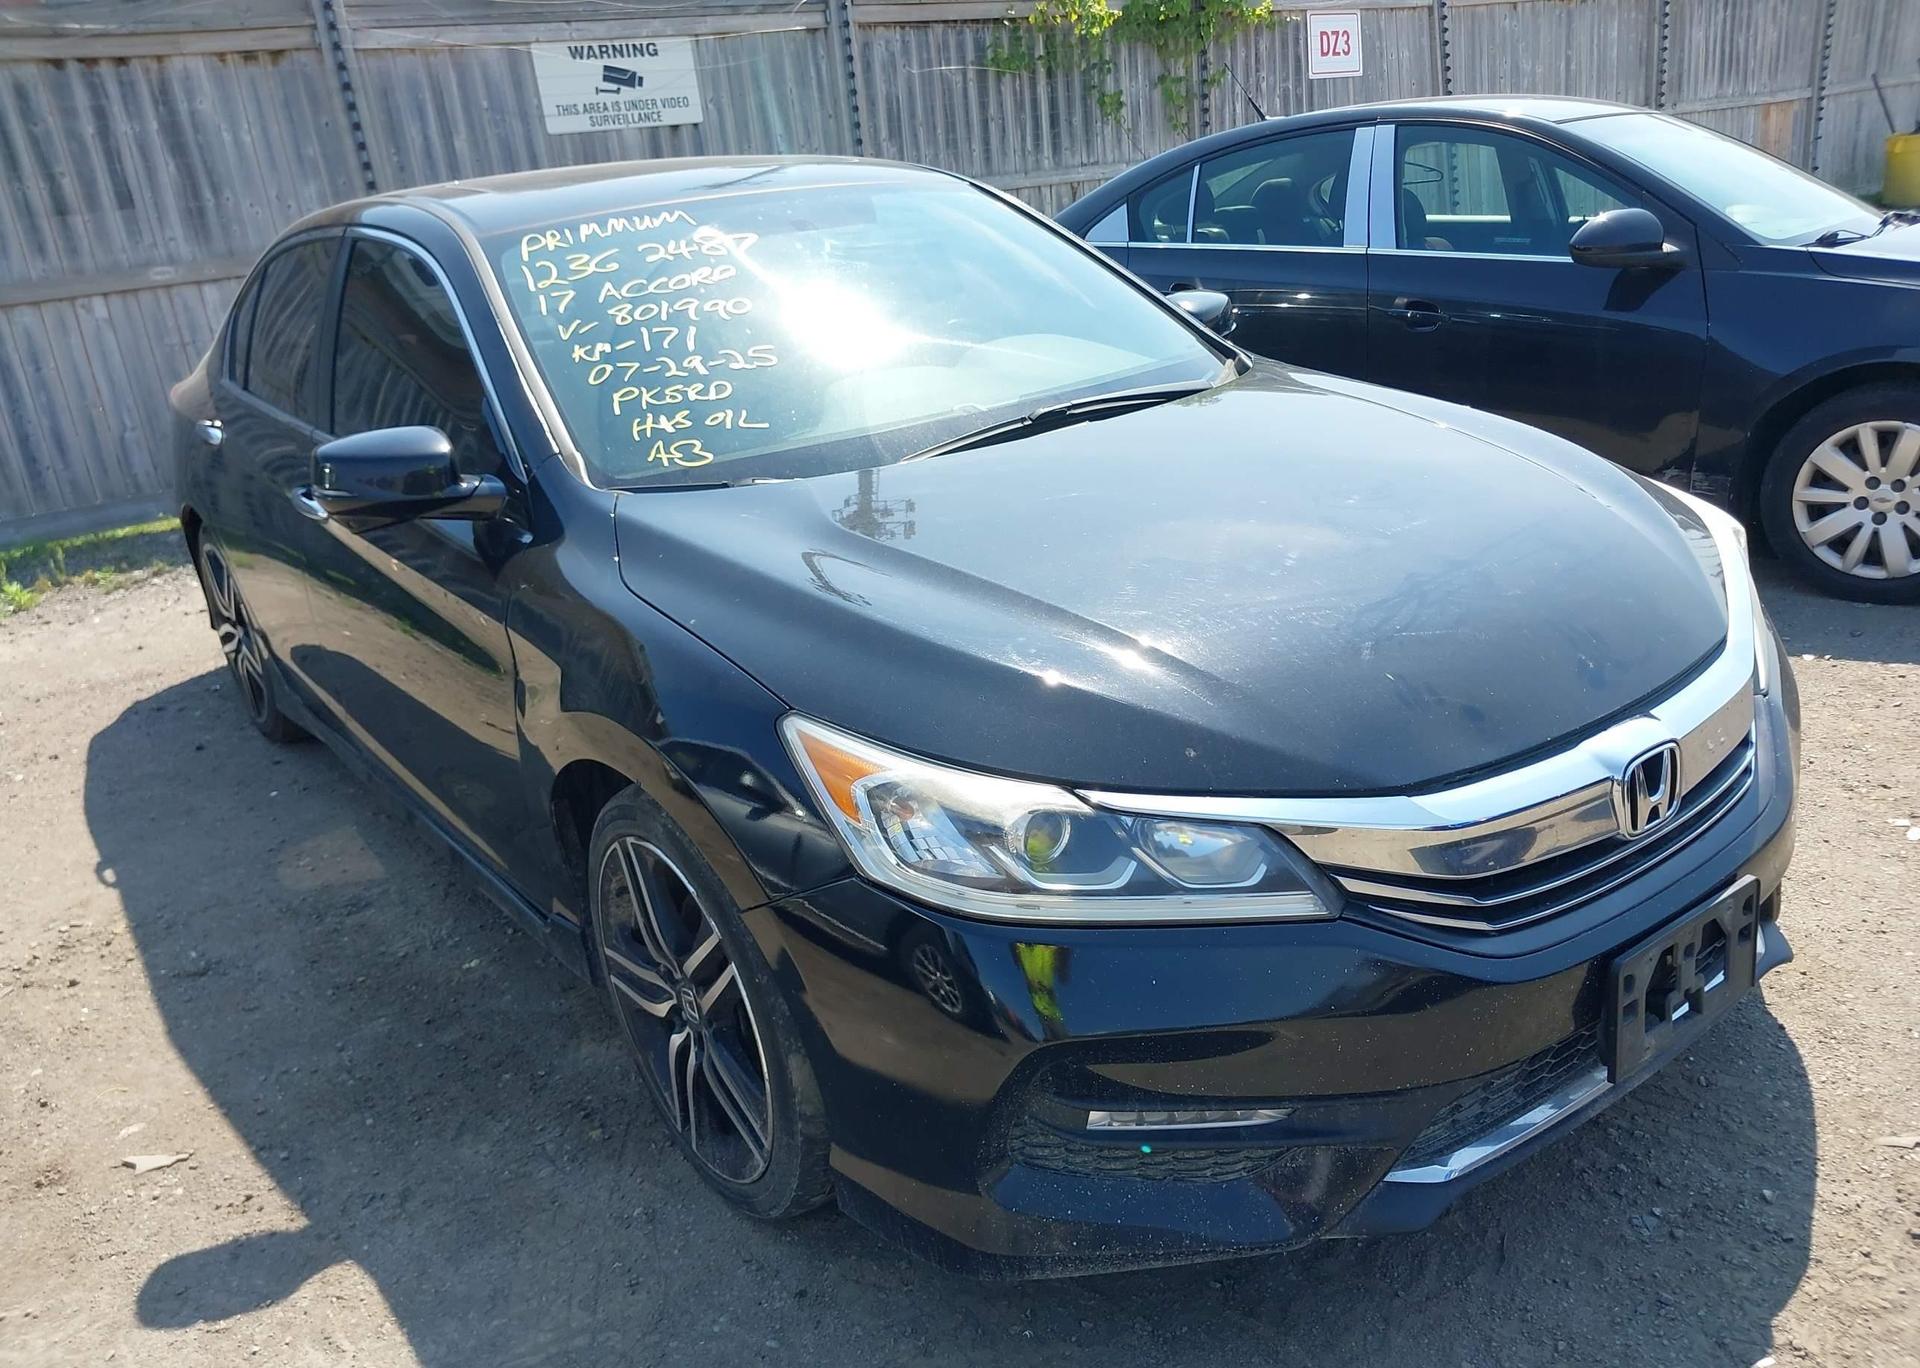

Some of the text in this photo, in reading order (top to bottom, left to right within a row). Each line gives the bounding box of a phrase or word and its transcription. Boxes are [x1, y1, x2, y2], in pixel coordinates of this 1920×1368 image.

[568, 42, 659, 60] WARNING
[1319, 30, 1351, 57] DZ3
[556, 96, 690, 117] THIS AREA IS UNDER VIDEO
[588, 111, 663, 128] SURVEILLANCE
[521, 209, 697, 262] PRIMMUM
[539, 264, 737, 316] 17 ACCORD
[588, 344, 778, 385] 07-29-25
